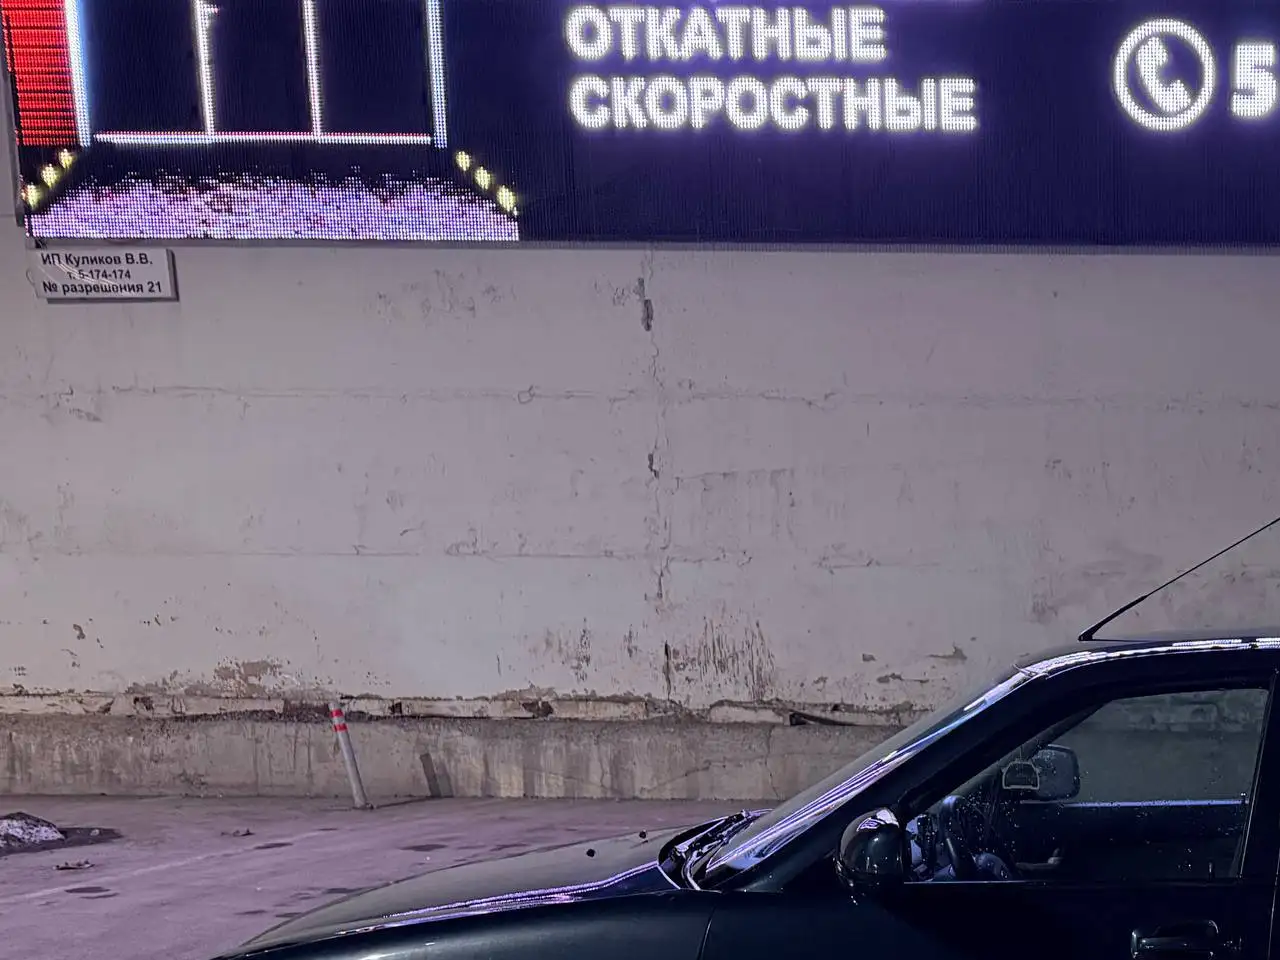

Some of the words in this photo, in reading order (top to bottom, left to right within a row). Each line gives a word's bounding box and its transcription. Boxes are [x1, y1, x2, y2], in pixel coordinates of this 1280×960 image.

[565, 4, 888, 61] ОТКАТНЫЕ
[569, 75, 978, 131] СКОРОСТНЫЕ
[41, 252, 61, 265] ИП
[64, 253, 121, 267] Куликов
[125, 252, 153, 265] В.В.
[78, 269, 131, 280] 5-174-174
[43, 280, 58, 293] №
[147, 281, 162, 293] 21
